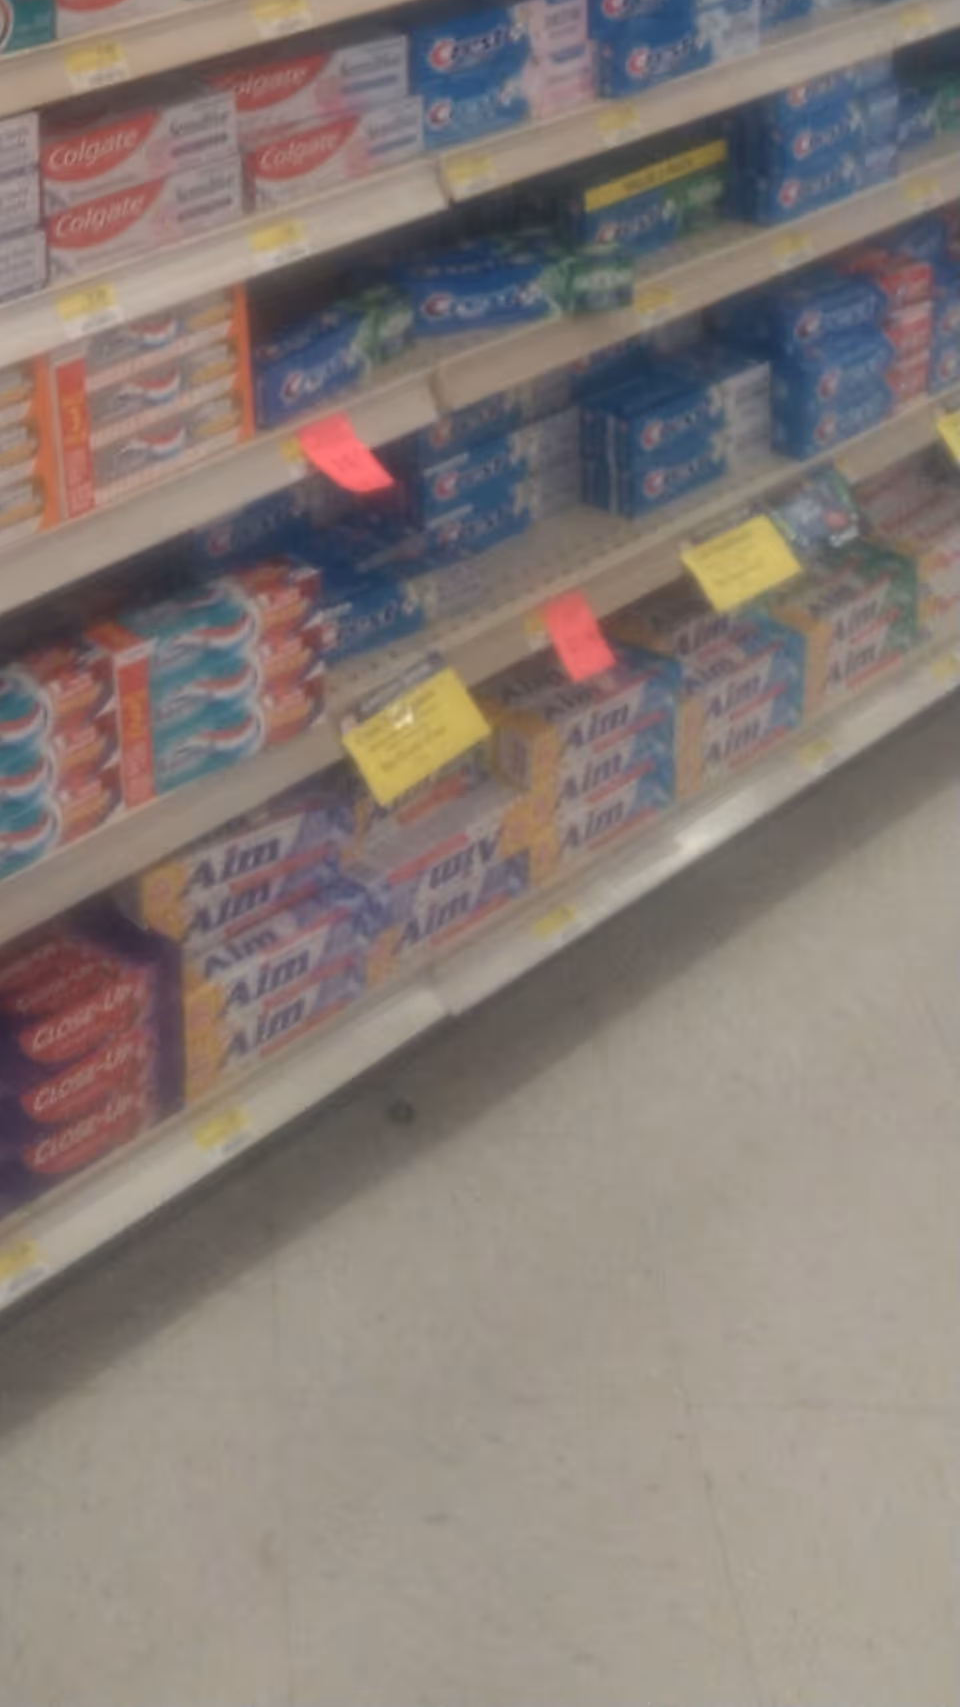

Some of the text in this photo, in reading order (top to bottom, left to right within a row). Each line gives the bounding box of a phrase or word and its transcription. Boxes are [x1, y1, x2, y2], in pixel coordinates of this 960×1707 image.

[48, 127, 138, 170] Colgate
[260, 132, 339, 168] Colgate
[55, 195, 144, 237] Colgate
[706, 673, 761, 721] Aim
[565, 703, 631, 750] Aim
[560, 754, 624, 800] Aim
[561, 801, 625, 848] Aim
[186, 837, 282, 892] Aim
[187, 883, 272, 940] Aim
[395, 892, 471, 954] Aim
[201, 927, 277, 978] Aim
[222, 950, 312, 1014] Aim
[222, 998, 307, 1064] Aim
